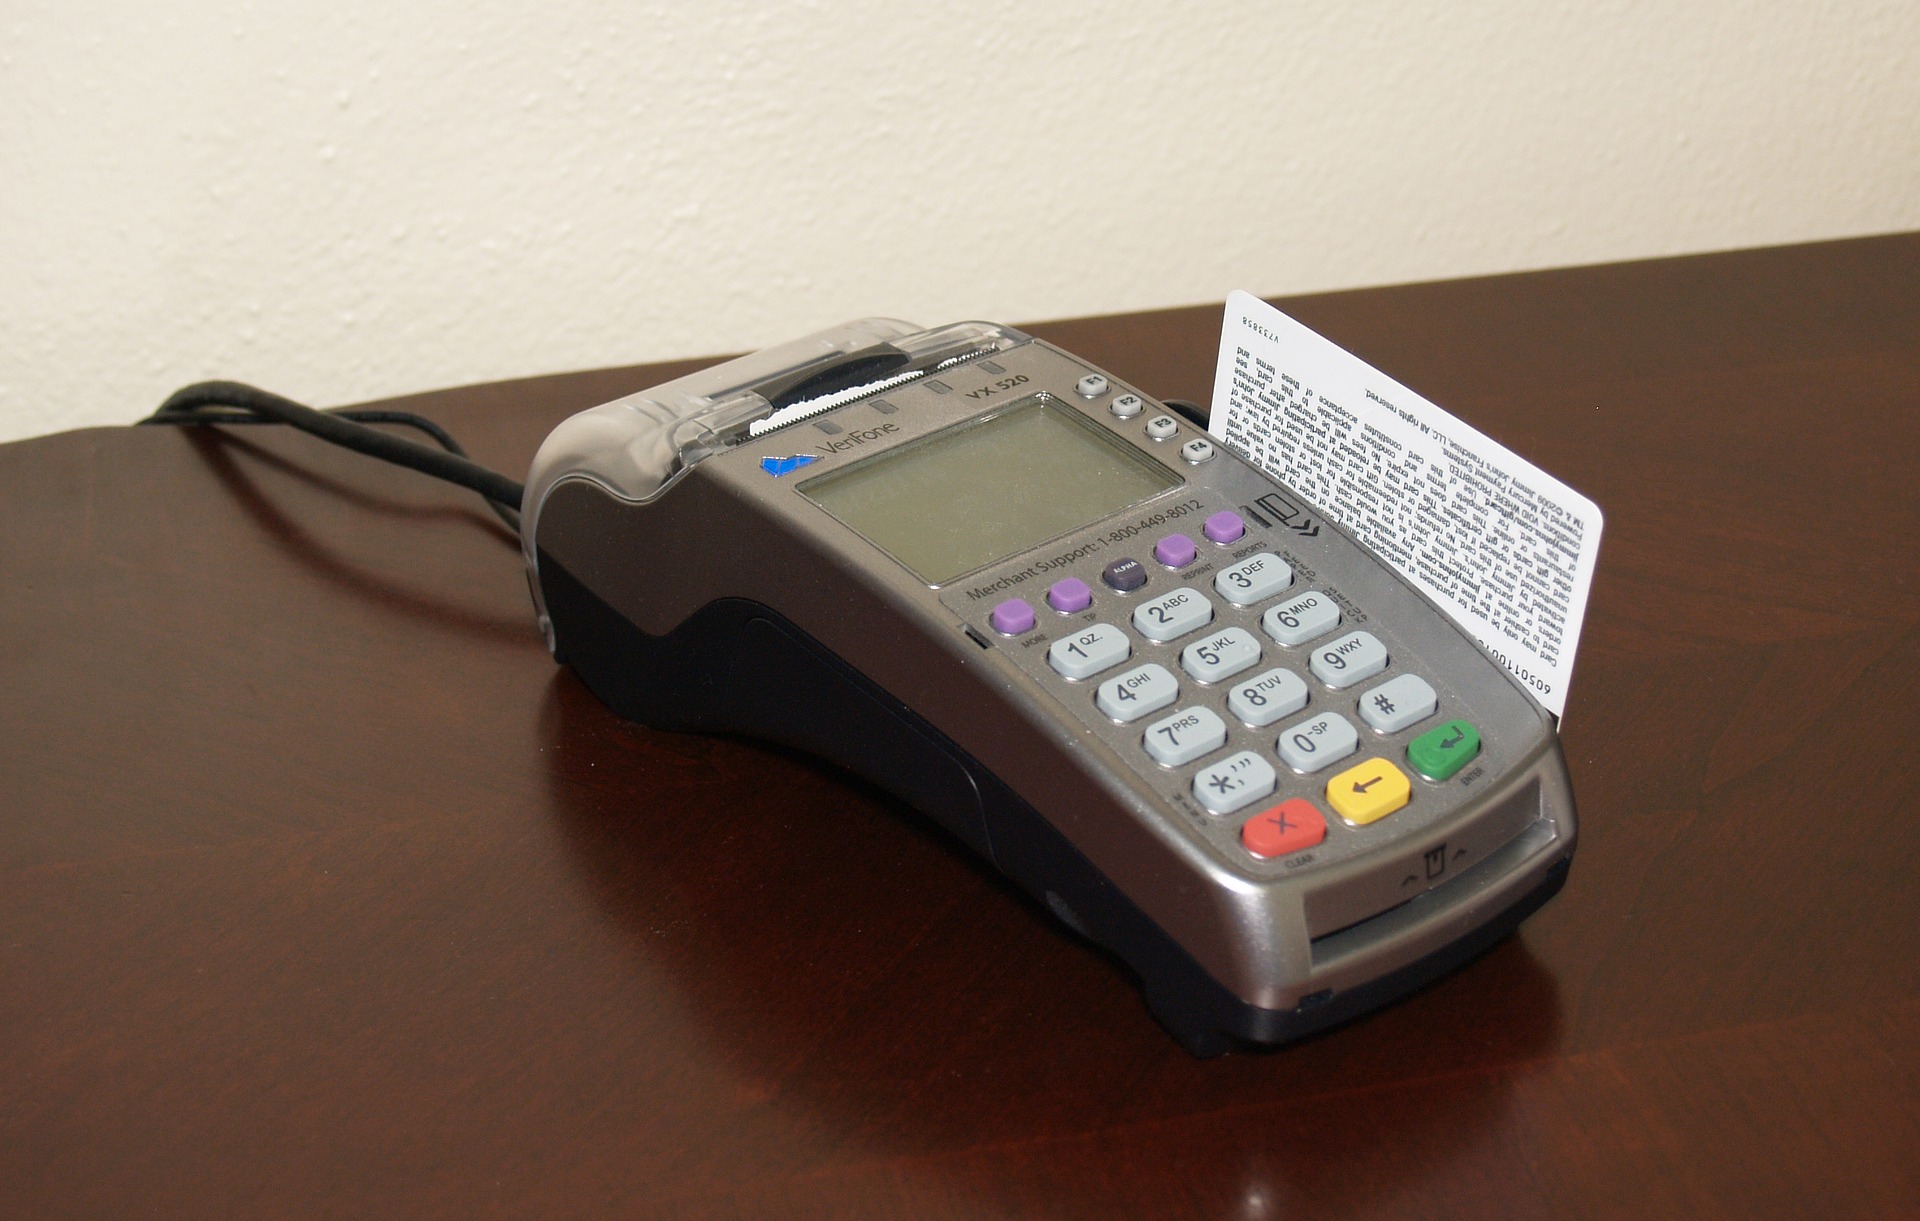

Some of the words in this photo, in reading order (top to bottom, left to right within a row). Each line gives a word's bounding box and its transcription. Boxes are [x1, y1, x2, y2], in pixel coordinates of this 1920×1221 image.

[1242, 316, 1279, 344] V733858
[1237, 346, 1250, 359] and
[1236, 357, 1248, 369] see
[1256, 358, 1275, 376] terms
[965, 385, 996, 401] VX
[998, 374, 1030, 391] 520
[1086, 376, 1103, 385] F1
[1233, 377, 1255, 397] John's
[1234, 367, 1265, 391] purchase
[1281, 373, 1300, 391] these
[1269, 388, 1285, 403] after
[1281, 384, 1293, 399] this
[1119, 396, 1137, 406] F2
[1258, 391, 1280, 413] Jimmy
[1229, 408, 1238, 420] for
[1289, 400, 1317, 423] charged
[1317, 406, 1352, 432] applicable
[1319, 396, 1358, 425] acceptance
[1398, 410, 1419, 427] rights
[1154, 418, 1172, 428] F3
[1227, 417, 1242, 432] until
[1253, 422, 1271, 439] cards
[1284, 406, 1326, 439] participating
[1420, 423, 1430, 436] All
[1246, 429, 1264, 445] value
[1334, 428, 1347, 440] will
[1364, 423, 1402, 452] constitutes
[1189, 442, 1207, 452] F4
[1275, 436, 1295, 454] stolen
[1352, 438, 1366, 454] fees
[1360, 432, 1396, 459] conditions
[1281, 451, 1293, 465] has
[1339, 442, 1369, 466] reloaded
[1408, 450, 1424, 465] card
[1297, 461, 1312, 476] card
[1310, 458, 1322, 472] lost
[1404, 460, 1417, 473] and
[1430, 464, 1443, 479] this
[1486, 463, 1510, 484] John's
[1316, 473, 1330, 489] This
[1326, 468, 1336, 481] for
[1385, 469, 1400, 485] may
[1413, 477, 1425, 489] not
[1426, 473, 1447, 493] terms
[1474, 468, 1506, 494] Payment
[1340, 476, 1379, 506] responsible
[1403, 482, 1419, 497] card
[1429, 487, 1447, 504] does
[1463, 485, 1477, 500] Use
[1511, 476, 1536, 500] Jimmy
[1356, 498, 1377, 516] would
[1423, 494, 1437, 510] This
[1451, 500, 1467, 515] card
[1456, 492, 1489, 517] complete
[1494, 492, 1520, 515] WHERE
[1508, 487, 1538, 513] Mercury
[1382, 503, 1394, 515] not
[1521, 509, 1539, 526] VOID
[1381, 514, 1394, 527] you
[1472, 514, 1487, 529] This
[1498, 518, 1509, 532] For
[1550, 514, 1583, 541] Powered
[1408, 519, 1431, 540] John's
[1411, 533, 1427, 548] card
[1434, 534, 1458, 558] Jimmy
[1485, 534, 1498, 546] gift
[966, 567, 1039, 600] Merchant
[1038, 541, 1100, 574] Support:
[1097, 499, 1204, 548] 1-800-449-8012
[1232, 540, 1267, 560] REPORTS
[1431, 546, 1444, 560] this
[1546, 548, 1559, 563] this
[1113, 560, 1138, 574] ALPHA
[1243, 560, 1265, 576] DEF
[1448, 557, 1474, 579] Protect
[1513, 551, 1533, 569] cards
[1533, 551, 1574, 582] restaurants
[1181, 563, 1214, 581] REPRINT
[1536, 566, 1549, 579] gift
[1492, 571, 1515, 594] Jimmy
[1553, 576, 1572, 593] other
[1162, 594, 1189, 611] ABC
[1290, 598, 1318, 616] MNO
[1518, 601, 1534, 615] your
[1532, 598, 1565, 624] activated
[1082, 612, 1097, 622] TIP
[1538, 614, 1563, 636] toward
[1021, 633, 1048, 649] MORE
[1212, 636, 1236, 652] JKL
[1336, 638, 1363, 655] WXY
[1126, 673, 1151, 688] GHI
[1256, 675, 1282, 692] TUV
[1171, 715, 1199, 732] PRS
[1460, 767, 1485, 786] ENTER
